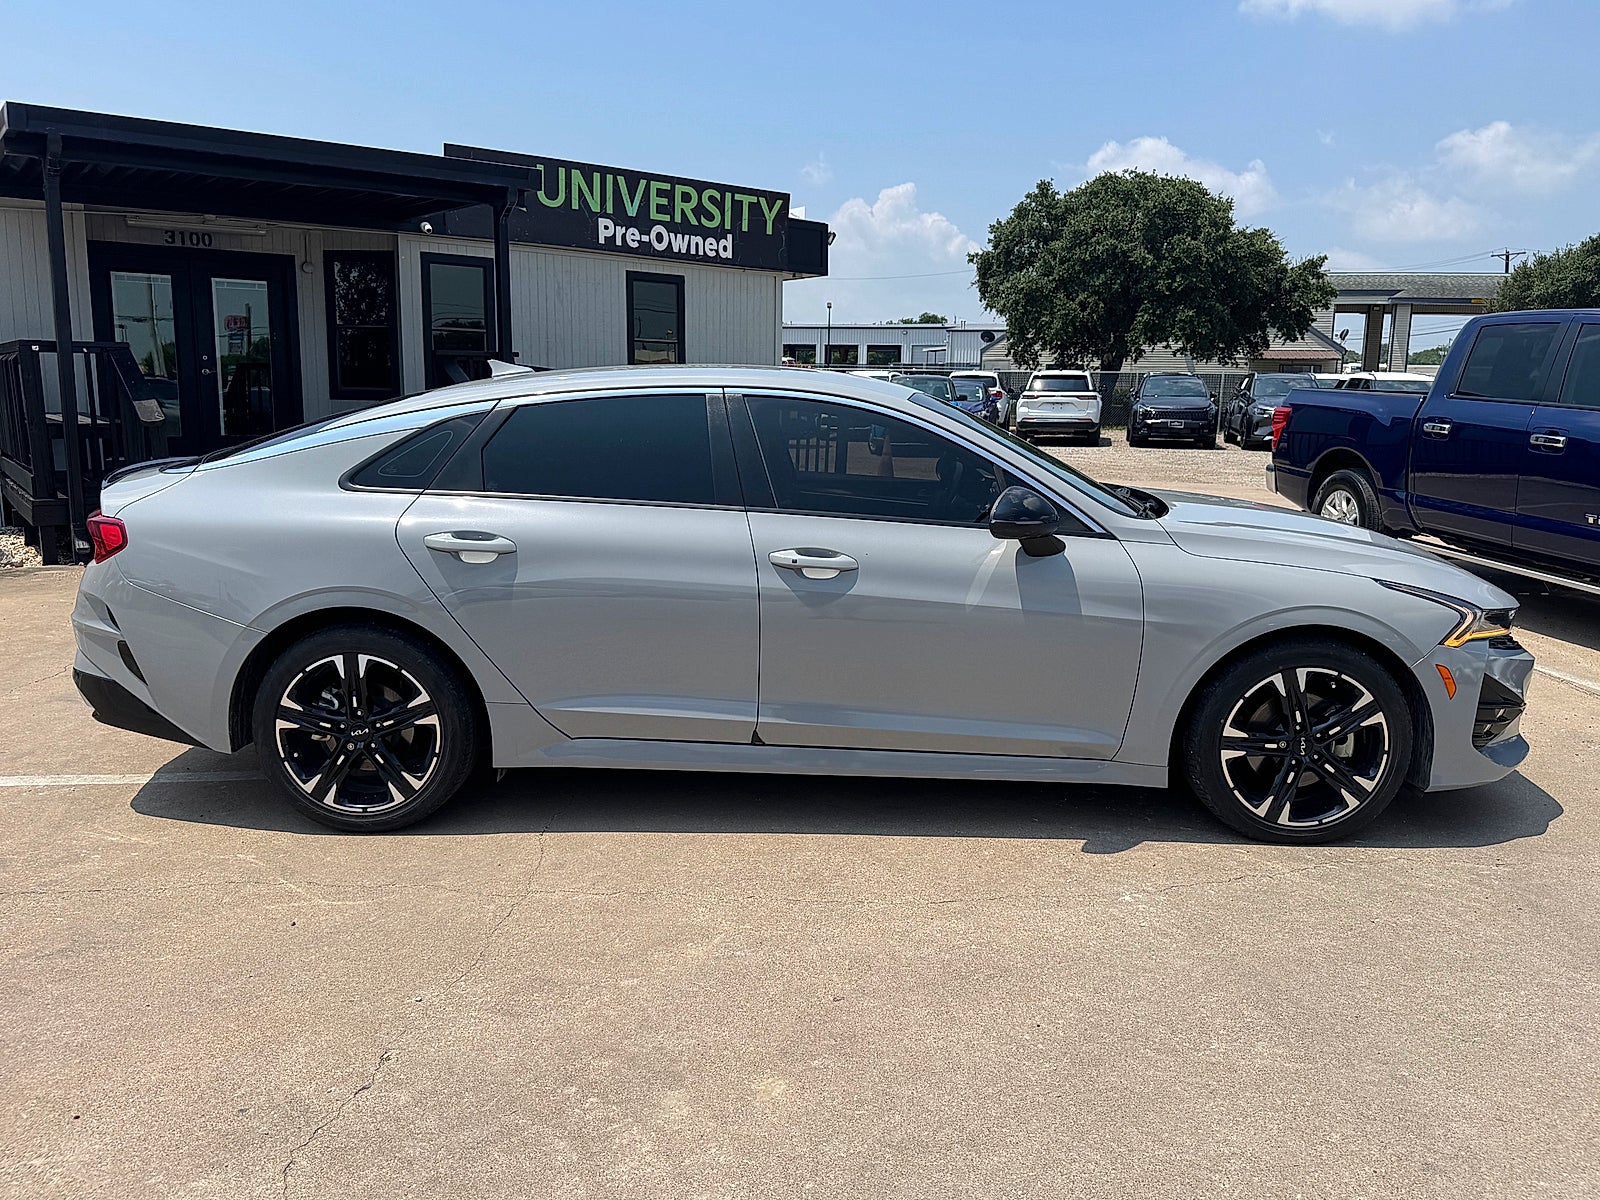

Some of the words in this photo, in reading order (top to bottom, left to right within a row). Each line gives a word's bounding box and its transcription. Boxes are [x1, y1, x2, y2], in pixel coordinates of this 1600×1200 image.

[537, 164, 783, 235] UNIVERSITY
[164, 230, 213, 248] 3100
[598, 217, 733, 259] Pre-Owned
